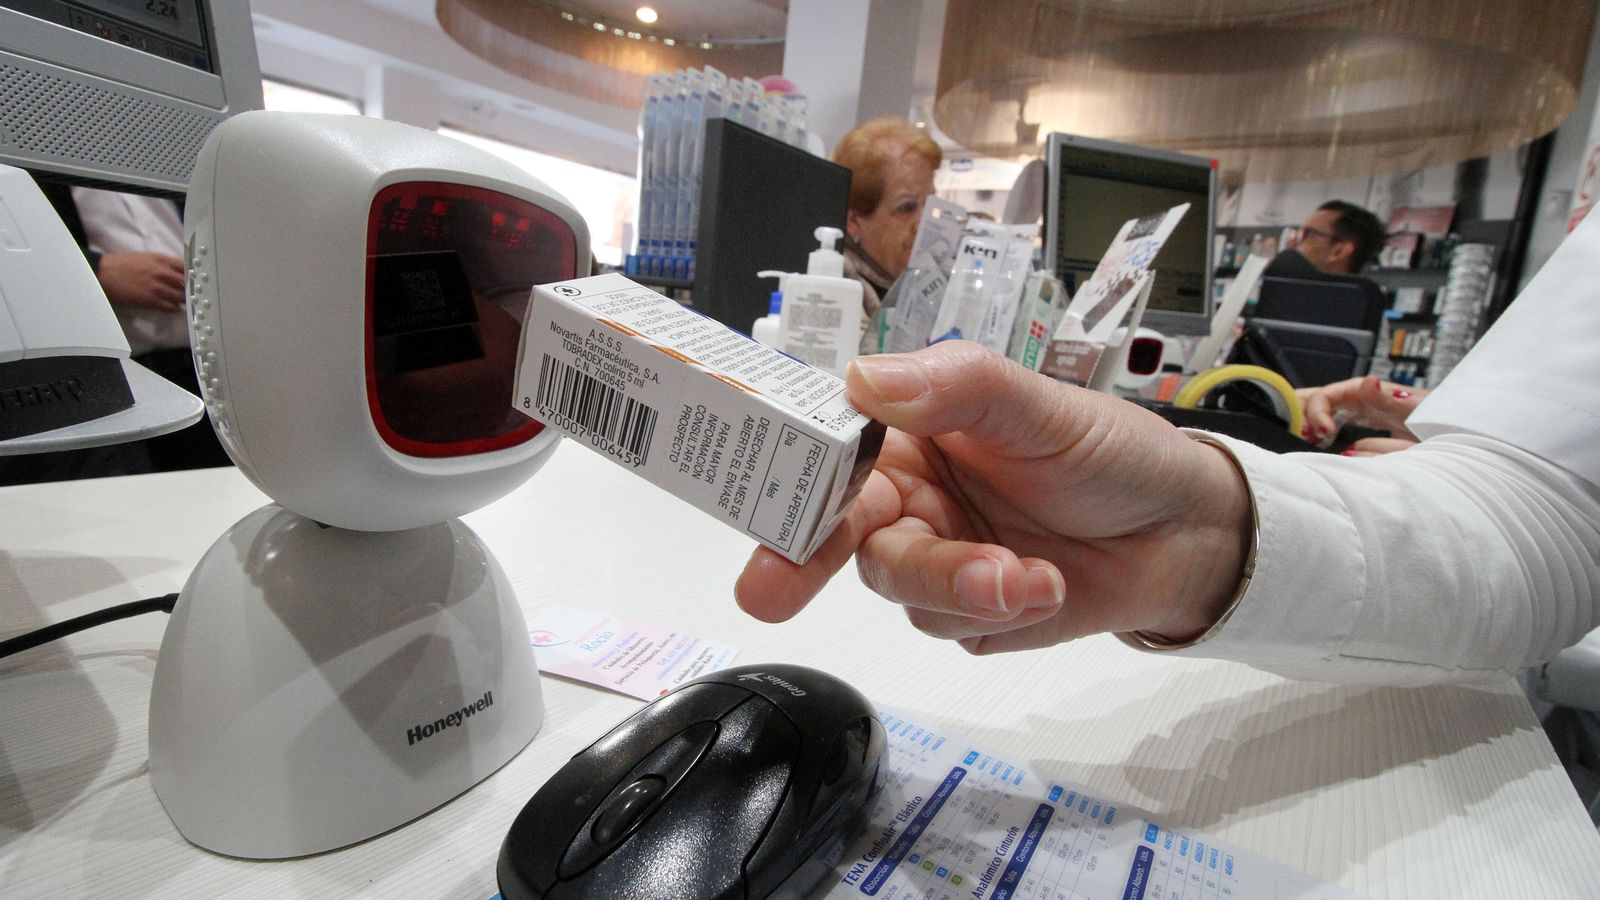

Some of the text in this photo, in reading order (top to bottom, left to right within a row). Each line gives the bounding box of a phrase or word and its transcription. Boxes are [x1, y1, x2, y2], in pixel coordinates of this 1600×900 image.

[550, 321, 660, 384] Novartis Farmacéutica, S.A.
[562, 339, 645, 388] TOBRADEX colirio 5 ml
[589, 329, 623, 353] A.S.S.S.
[594, 368, 626, 390] 700645
[524, 397, 641, 468] 8 470007 006459
[669, 404, 692, 463] PROSPECTO
[679, 404, 706, 474] CONSULTAR EL
[692, 413, 718, 479] INFORMACIÓN
[705, 421, 731, 485] PARA MAYOR
[718, 414, 755, 510] ABIERTO EL ENVASE
[801, 443, 821, 476] FECHA
[729, 417, 770, 520] DESECHAR AL MES DE
[796, 478, 809, 493] DE
[764, 675, 807, 697] Genius
[406, 691, 493, 746] Honeywell
[841, 862, 868, 886] TENA
[895, 795, 923, 822] Elástico
[971, 854, 1002, 900] Anatómico
[995, 826, 1020, 857] Cinturón
[864, 864, 889, 893] Absorción
